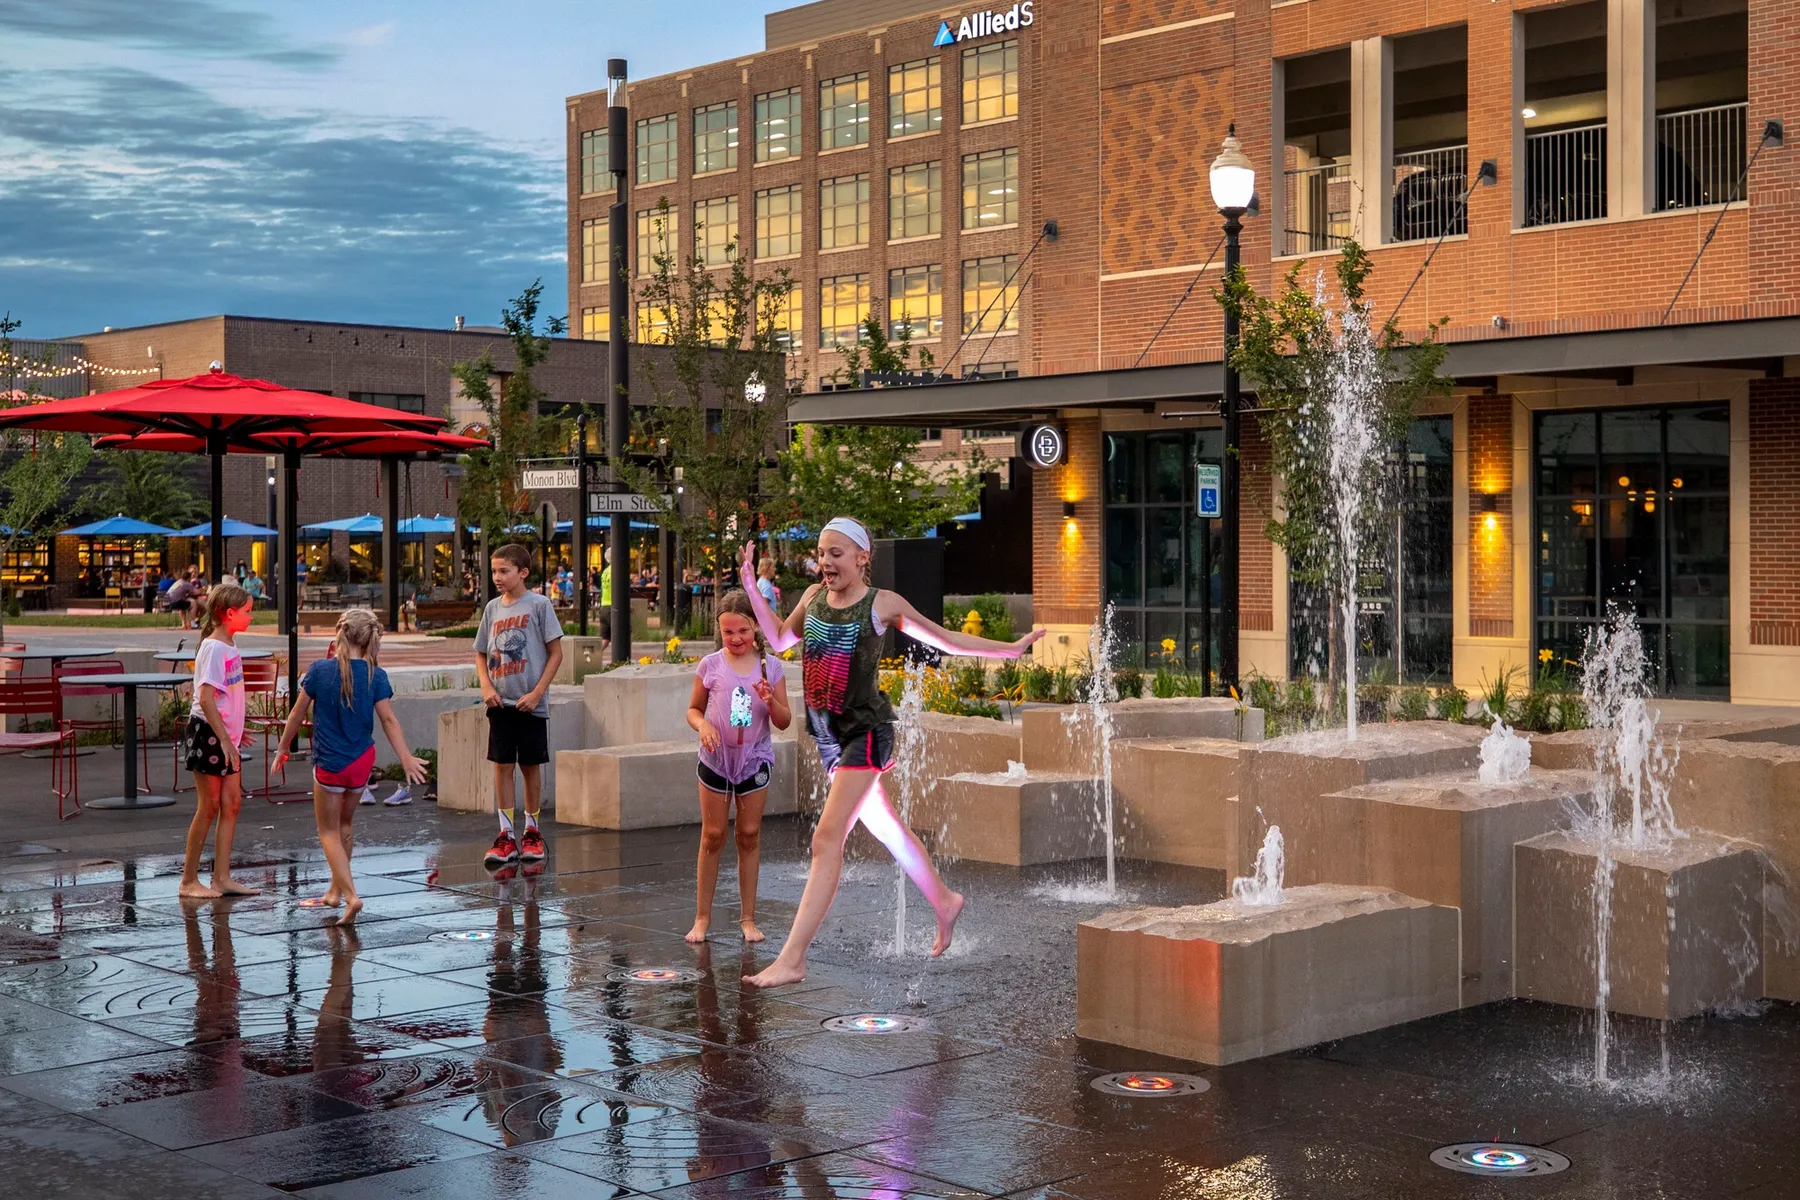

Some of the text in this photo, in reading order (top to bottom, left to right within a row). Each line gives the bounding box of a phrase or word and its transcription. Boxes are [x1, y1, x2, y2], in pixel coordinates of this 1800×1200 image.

[524, 472, 577, 487] Monon Blvd
[597, 495, 623, 510] Elm
[493, 613, 531, 637] TRIPLE
